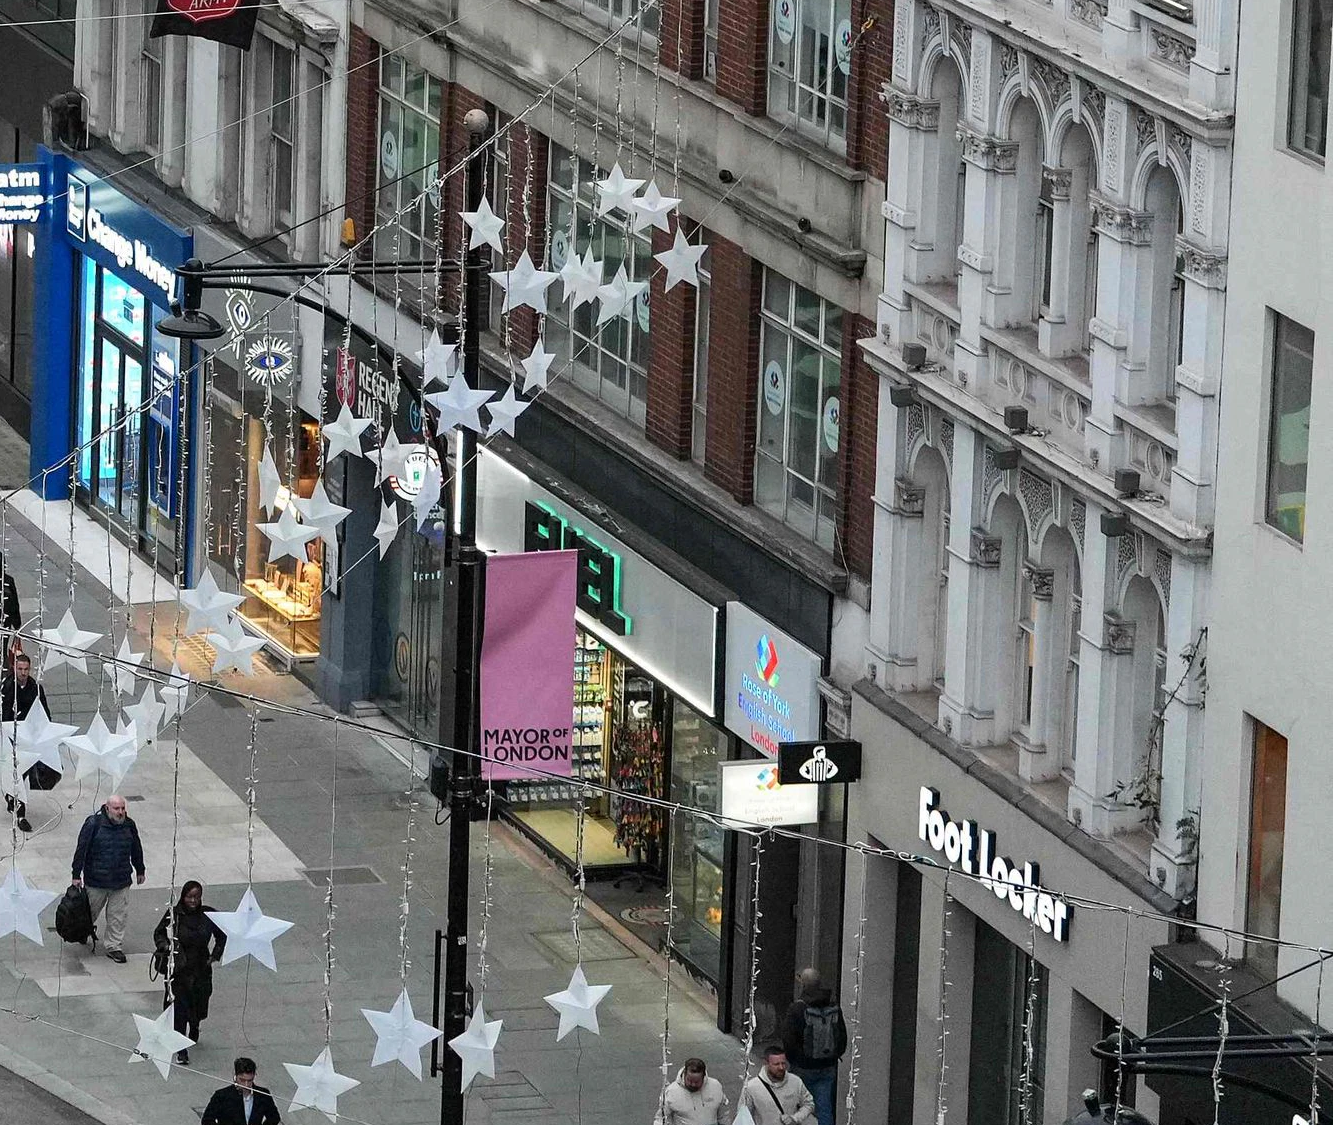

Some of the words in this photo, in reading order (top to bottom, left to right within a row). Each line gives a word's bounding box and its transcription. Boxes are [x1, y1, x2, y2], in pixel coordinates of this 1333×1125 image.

[87, 207, 134, 268] Change
[134, 239, 176, 302] Money
[358, 361, 400, 406] REGEN
[737, 692, 767, 726] English
[768, 714, 796, 742] School
[741, 673, 762, 699] Rose
[762, 689, 773, 706] of
[772, 693, 791, 720] York
[484, 728, 551, 746] MAYOR
[552, 727, 569, 739] OF
[484, 745, 569, 763] LONDON
[918, 785, 978, 875] Foot
[979, 828, 1075, 943] Locker
